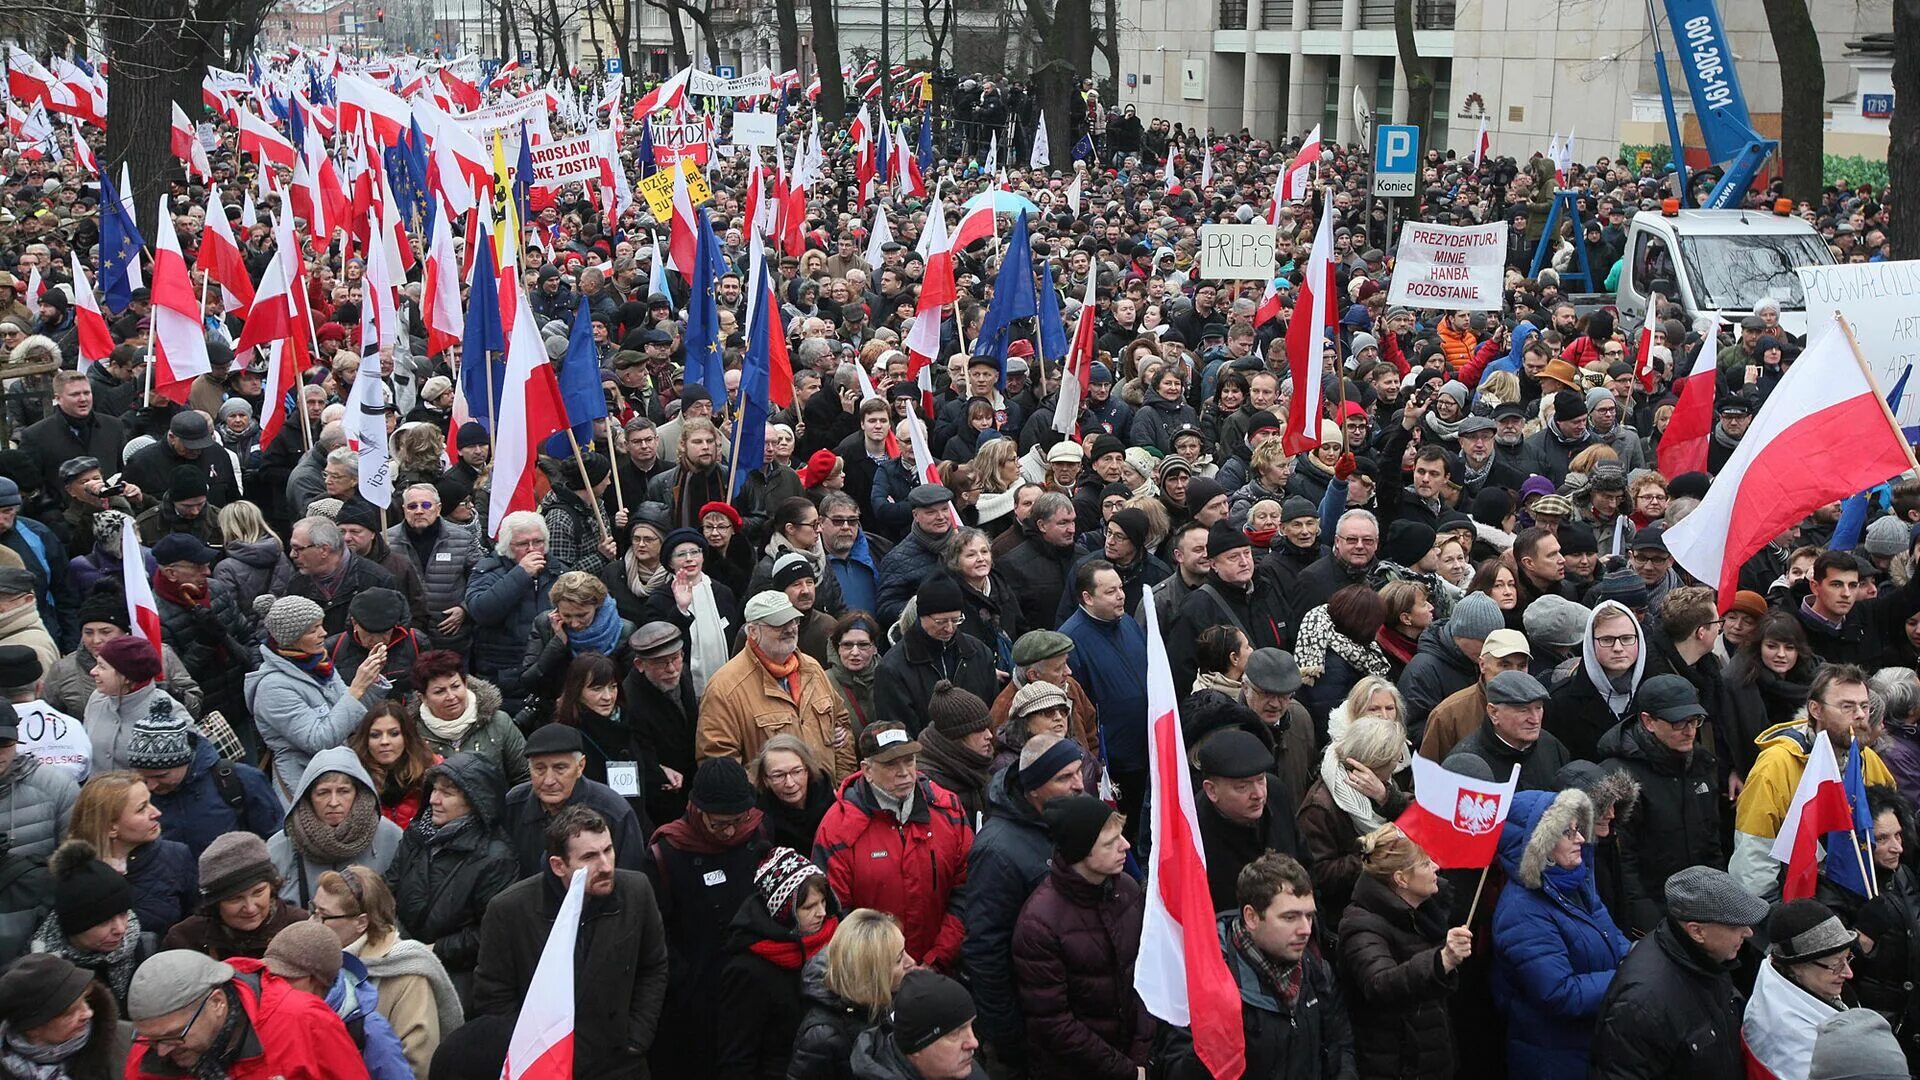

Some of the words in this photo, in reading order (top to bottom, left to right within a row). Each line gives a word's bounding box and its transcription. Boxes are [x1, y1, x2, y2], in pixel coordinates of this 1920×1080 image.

[1684, 15, 1733, 110] 601-206-191
[529, 140, 589, 164] AROSŁAW
[1385, 131, 1410, 167] P
[507, 166, 554, 180] PSKĘ
[1377, 180, 1413, 191] Koniec
[1413, 231, 1498, 247] PREZYDENTURA
[1434, 251, 1466, 264] MINIE
[1430, 265, 1469, 280] HAŃBA
[1406, 282, 1479, 299] POZOSTANIE
[613, 773, 634, 785] KOD
